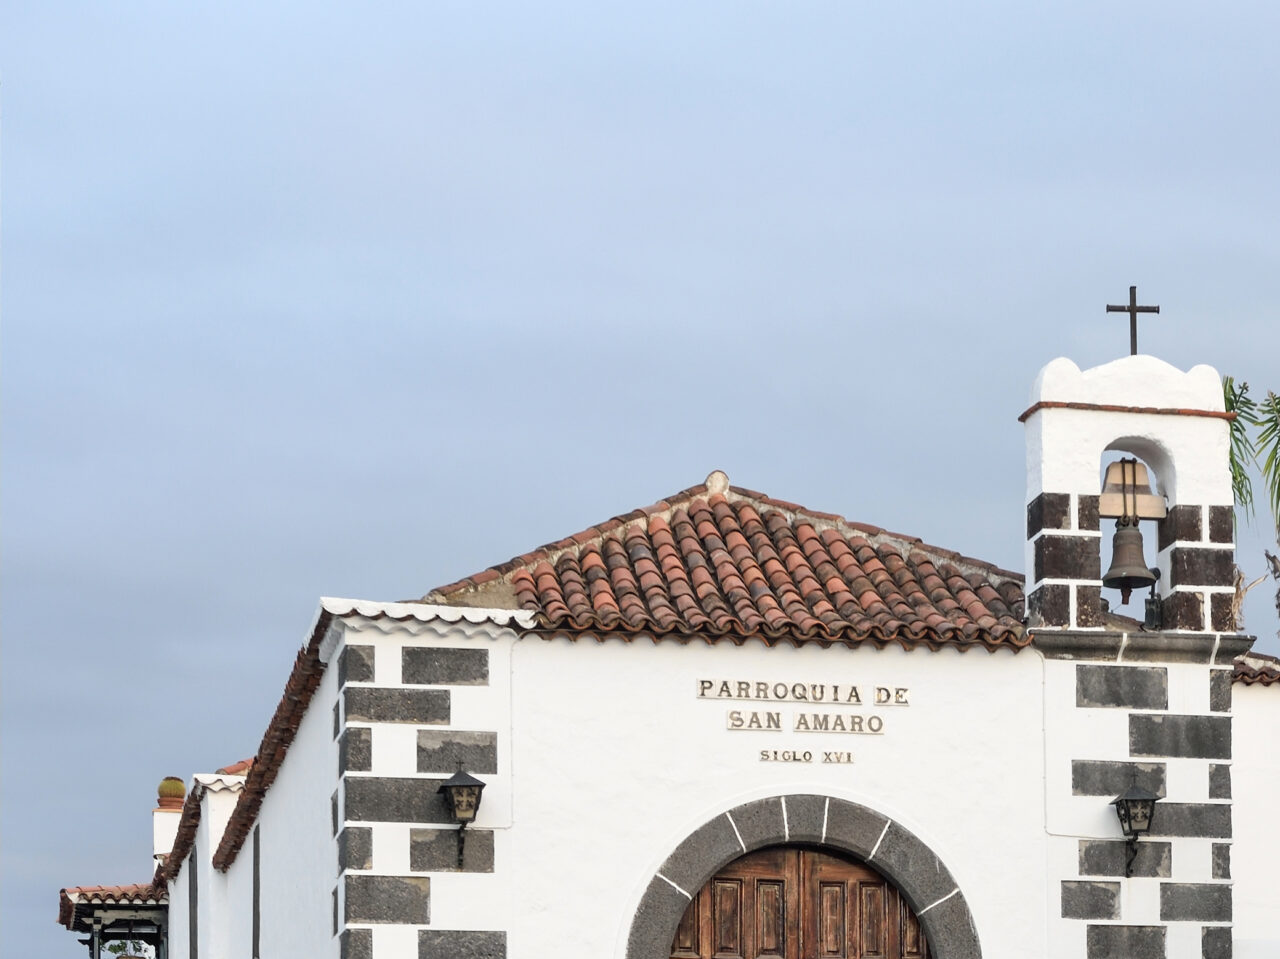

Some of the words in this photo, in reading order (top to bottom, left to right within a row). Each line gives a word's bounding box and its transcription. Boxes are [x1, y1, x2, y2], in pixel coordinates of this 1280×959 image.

[700, 679, 861, 703] PARROQUIA
[876, 687, 909, 704] DE
[729, 710, 781, 729] SAN
[795, 713, 883, 732] AMARO
[760, 750, 812, 761] SIGLO
[823, 752, 852, 762] XVI
